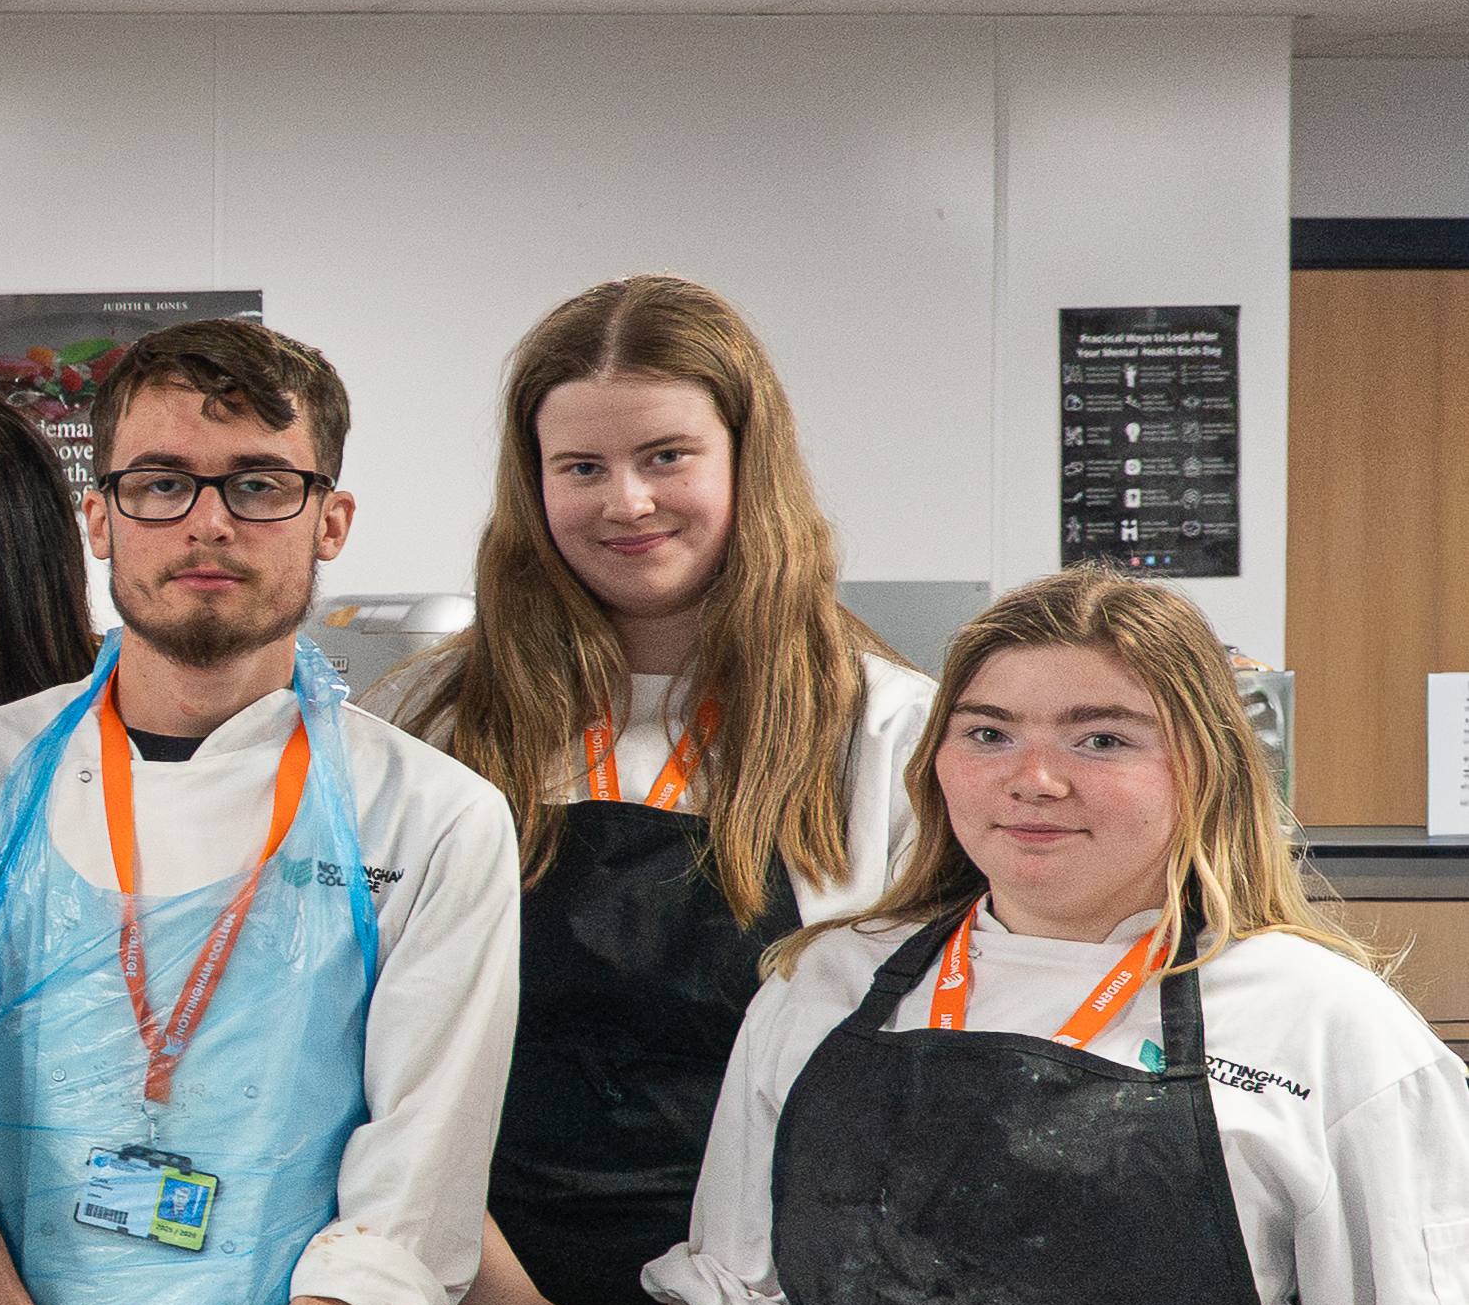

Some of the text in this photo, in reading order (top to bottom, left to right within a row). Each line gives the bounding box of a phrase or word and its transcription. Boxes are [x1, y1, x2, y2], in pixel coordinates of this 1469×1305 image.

[103, 301, 142, 312] JUDITH
[155, 300, 189, 311] JONES
[1101, 346, 1139, 358] Mental
[125, 925, 139, 978] COLLEGE
[174, 961, 216, 1037] NOTTINGHAM
[1091, 970, 1132, 1013] STUDENT
[1205, 1055, 1311, 1101] OTTINGHAM
